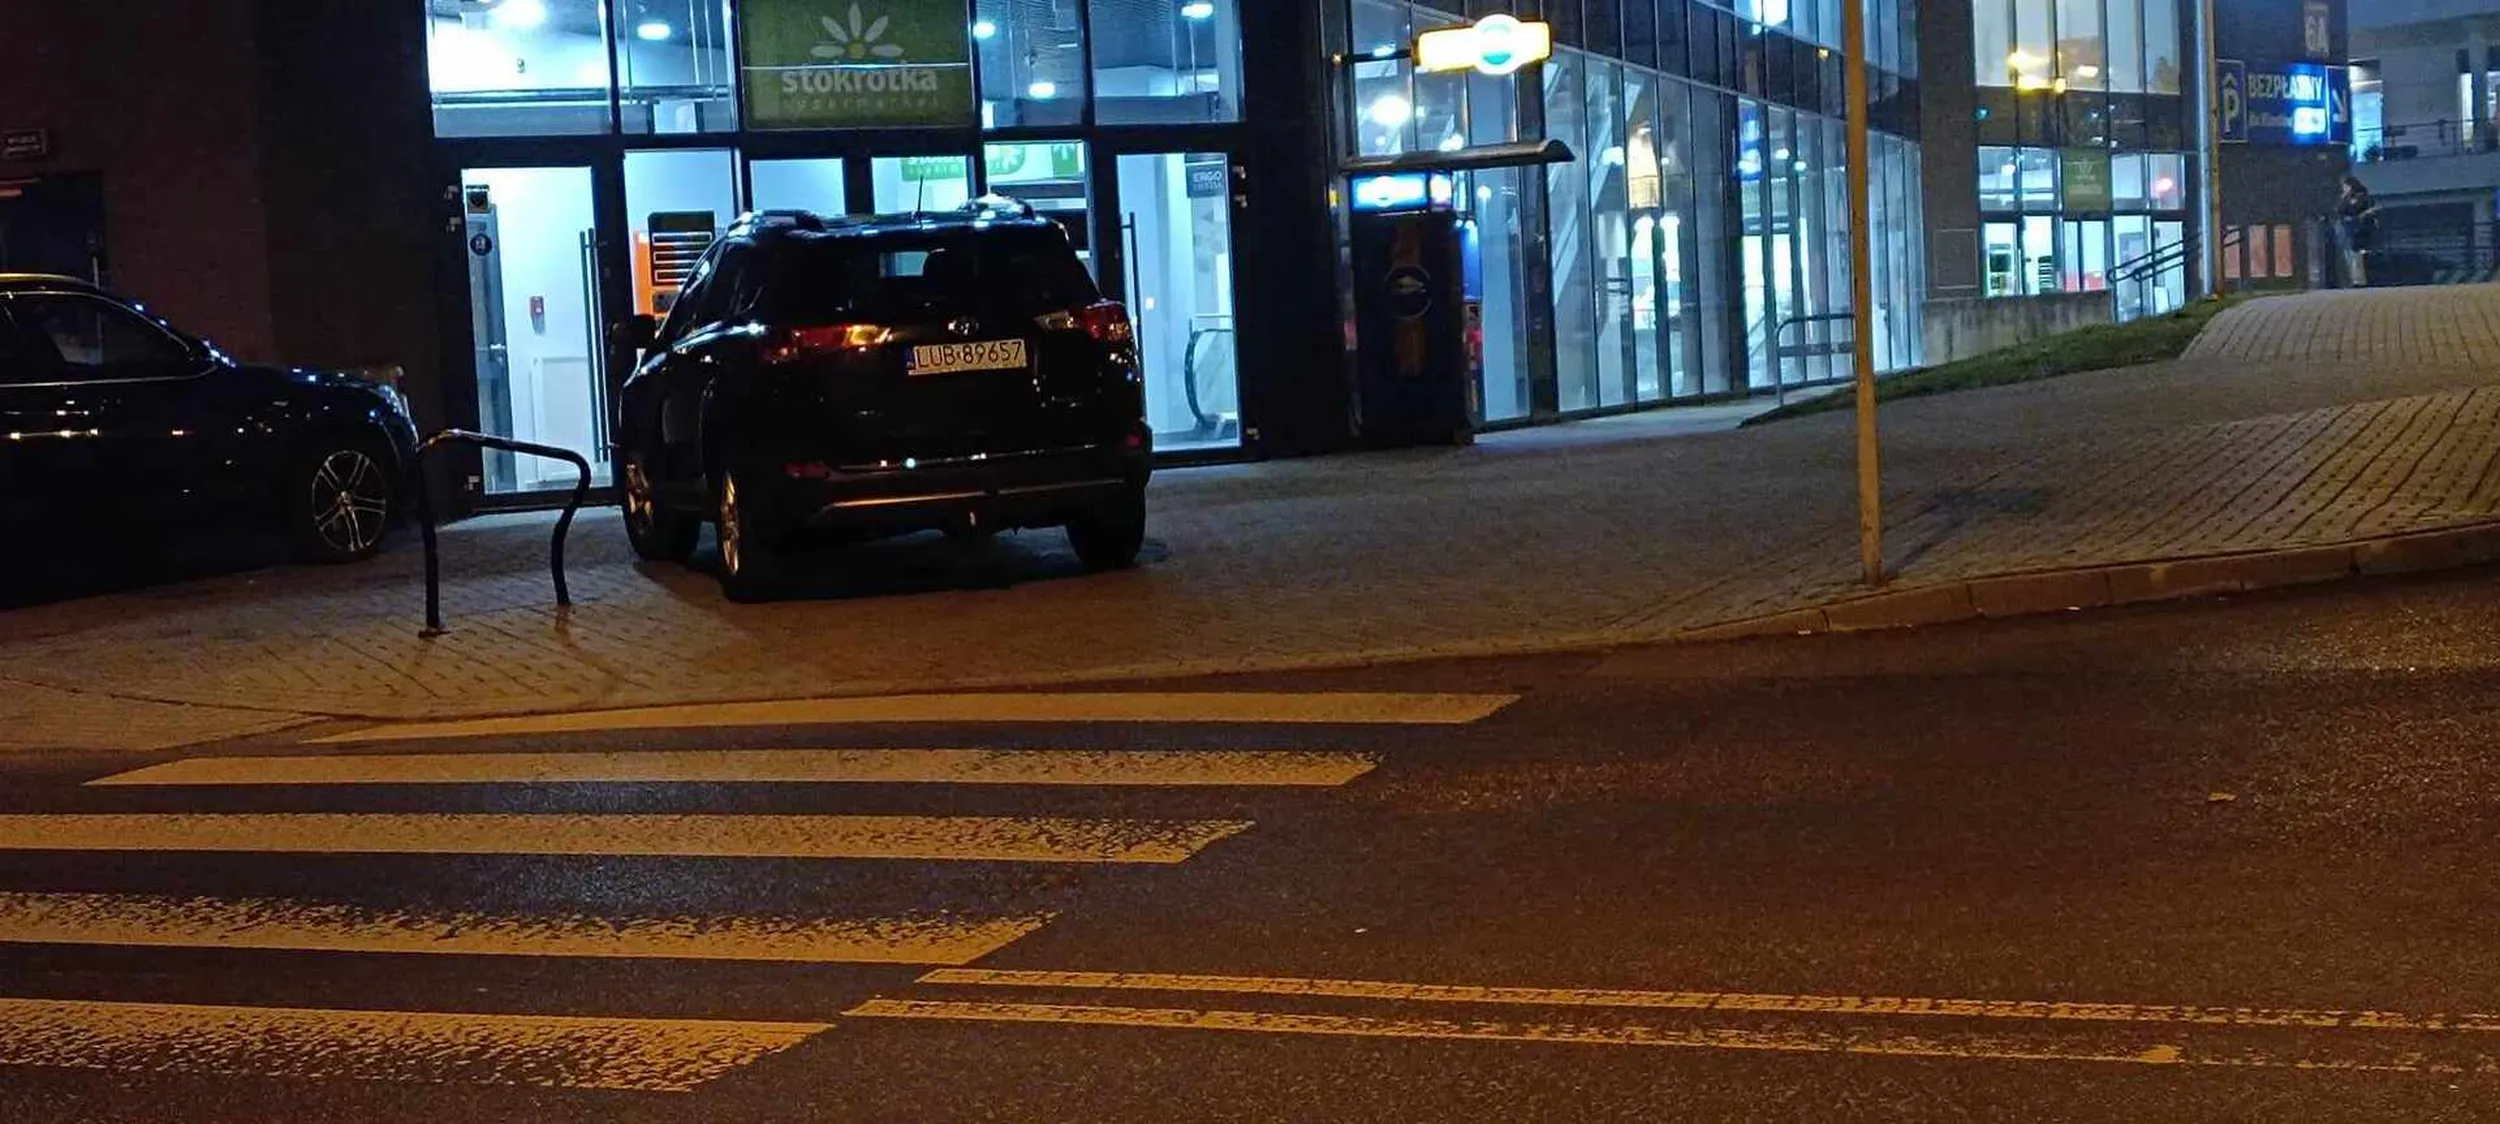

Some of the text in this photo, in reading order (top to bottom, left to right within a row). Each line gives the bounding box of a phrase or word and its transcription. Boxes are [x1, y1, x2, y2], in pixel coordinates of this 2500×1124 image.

[781, 60, 938, 93] stokrotka
[2247, 73, 2323, 101] BEZPŁANY
[915, 340, 1022, 368] LUB 89657
